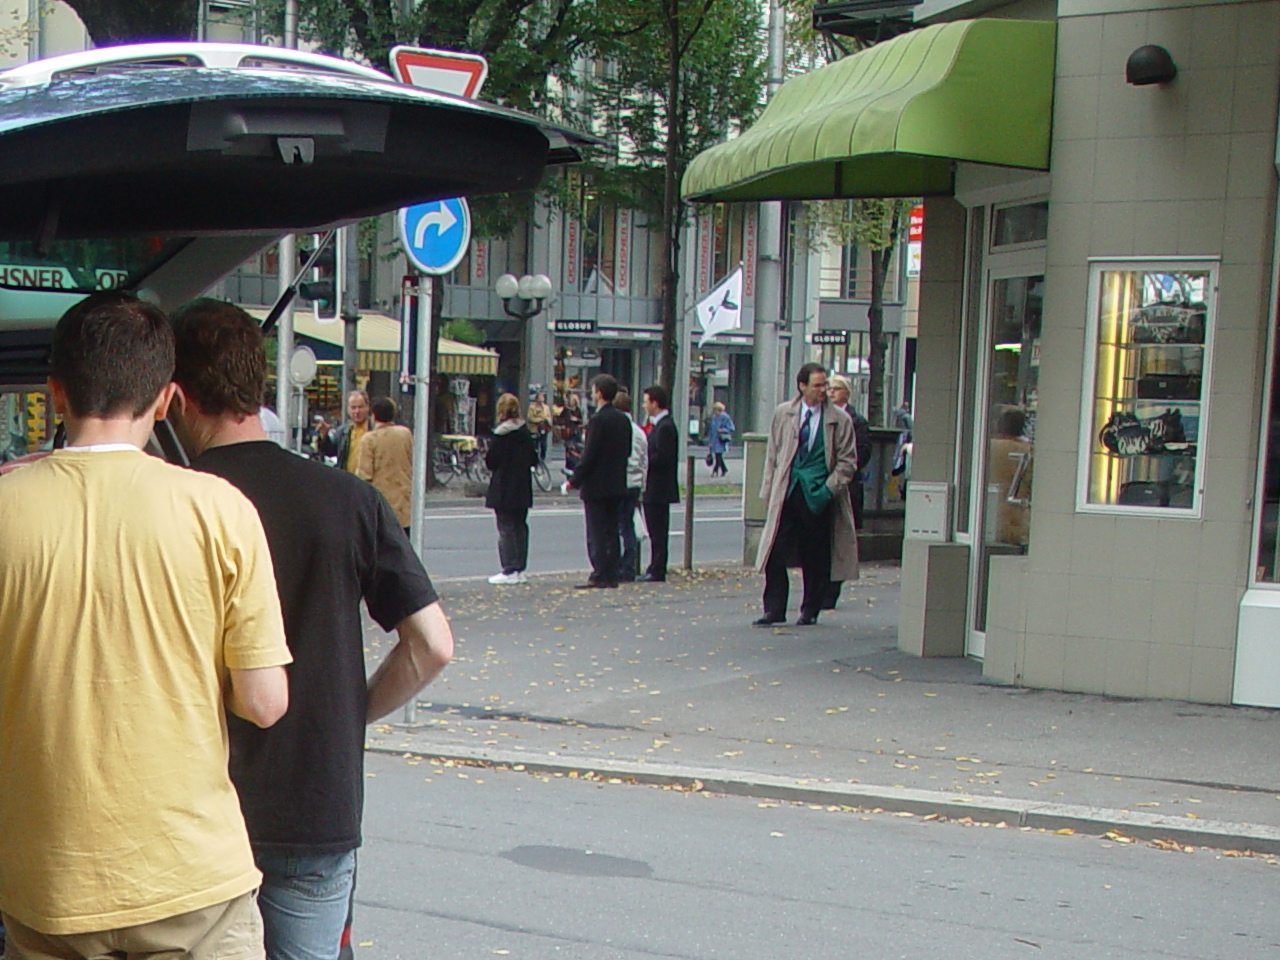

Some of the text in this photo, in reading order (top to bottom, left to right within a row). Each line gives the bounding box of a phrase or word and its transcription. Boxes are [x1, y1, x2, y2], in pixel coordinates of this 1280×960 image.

[619, 227, 629, 288] OCHSNER
[557, 322, 592, 330] GLOBUS
[813, 335, 846, 343] GLOBUS
